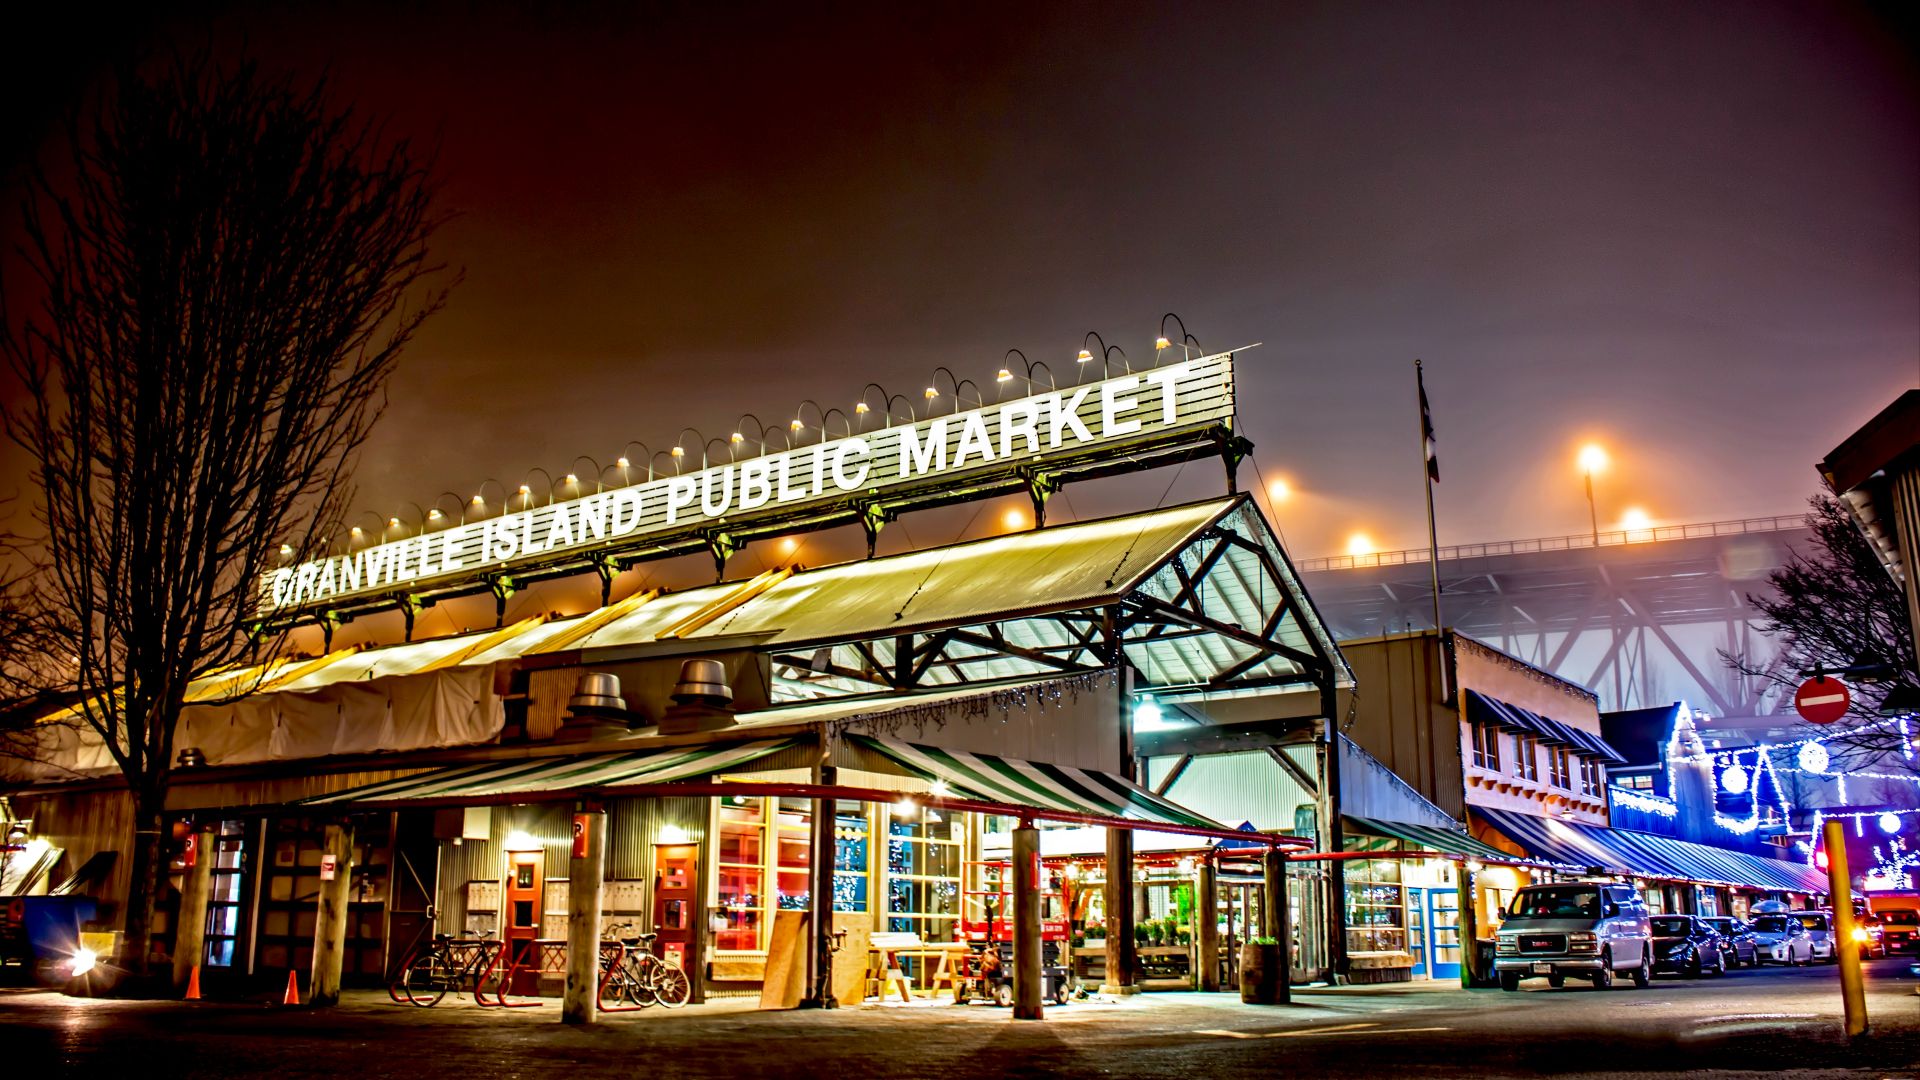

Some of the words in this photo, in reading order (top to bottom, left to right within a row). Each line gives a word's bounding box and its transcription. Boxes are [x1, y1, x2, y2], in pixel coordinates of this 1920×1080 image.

[272, 526, 466, 607] GRANVILLE
[481, 489, 643, 563] ISLAND
[667, 438, 870, 525] PUBLIC
[899, 364, 1190, 479] MARKET
